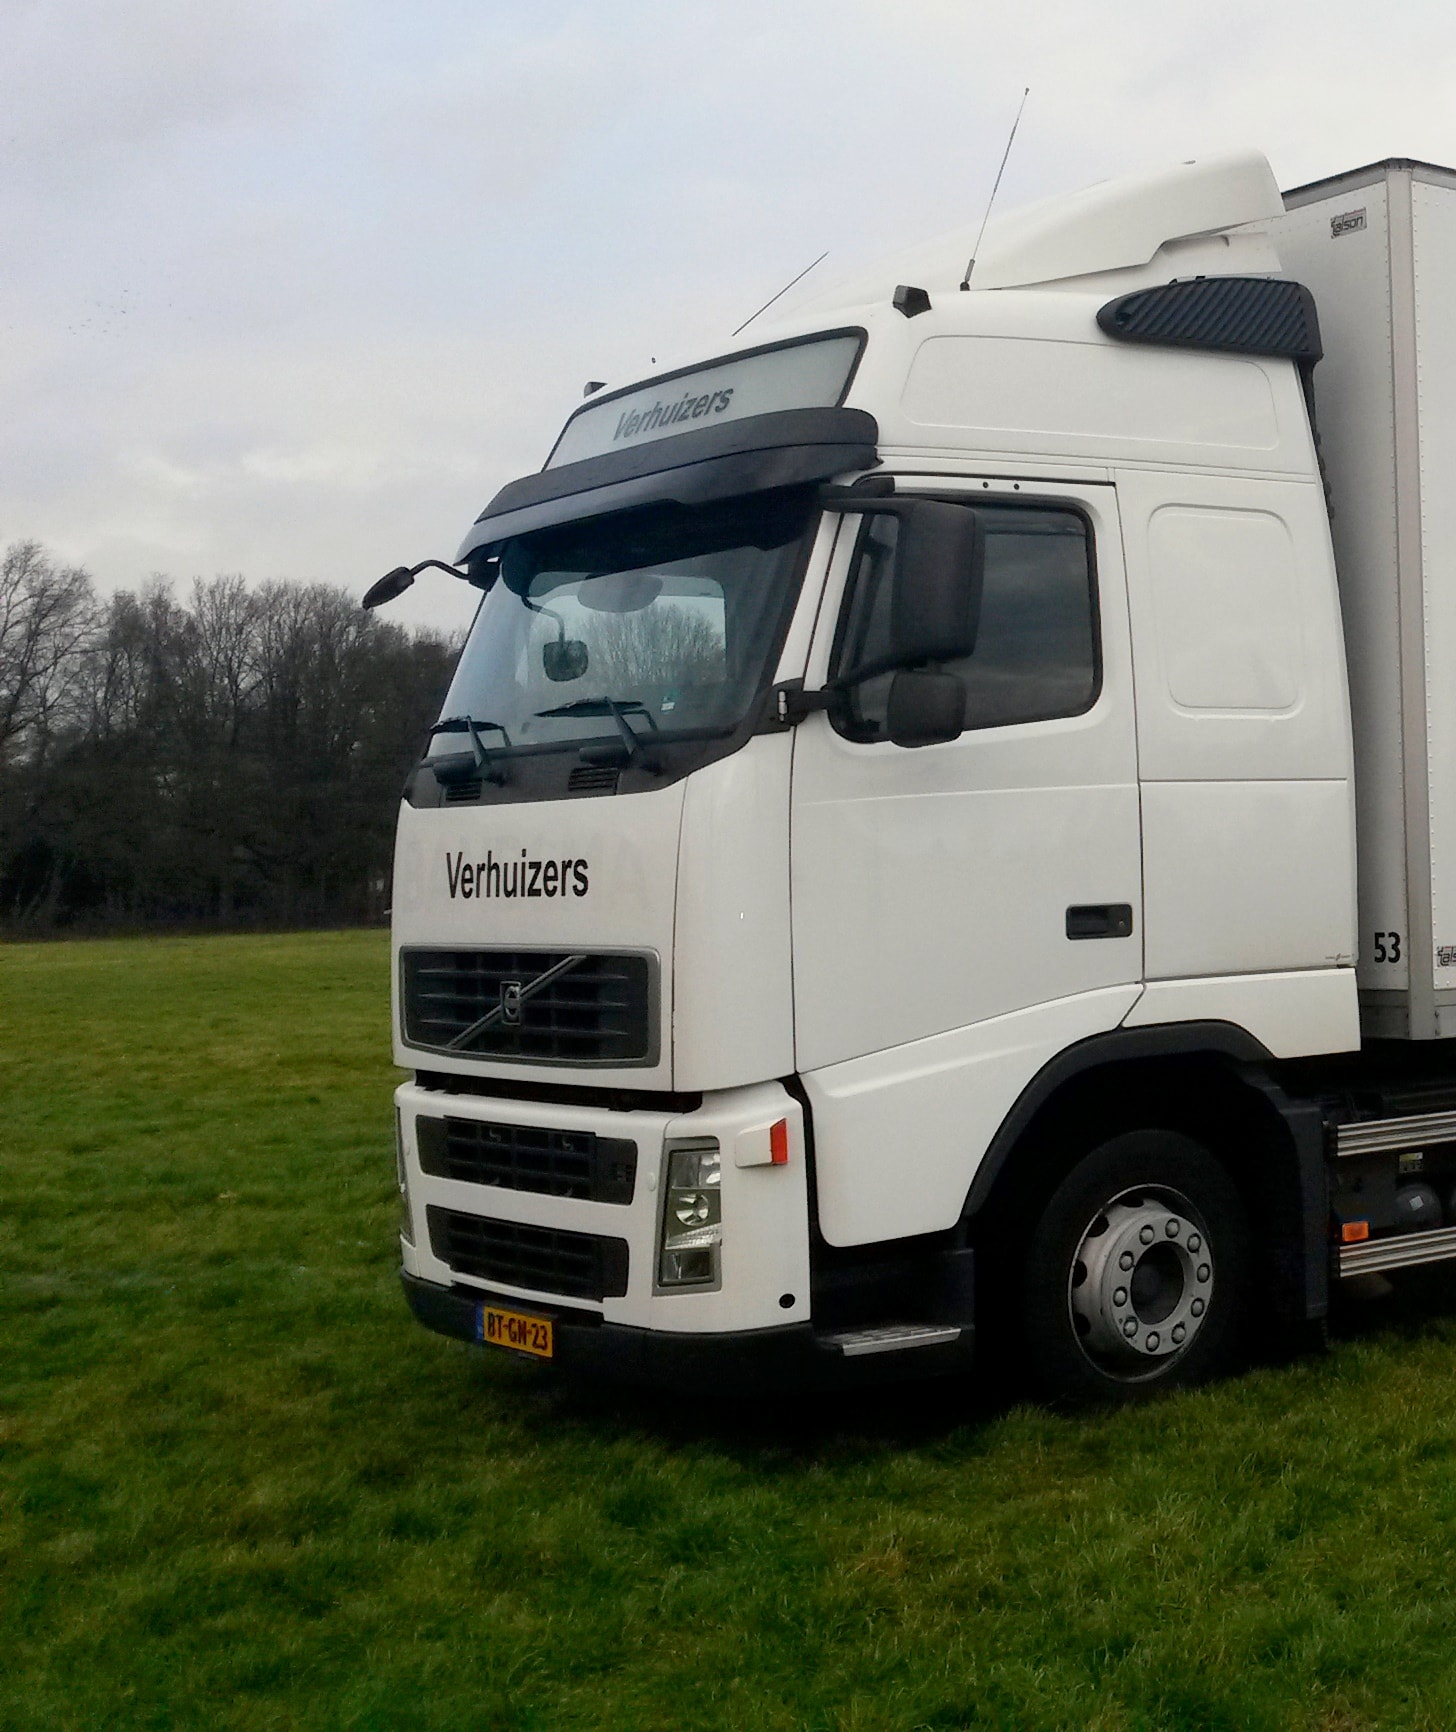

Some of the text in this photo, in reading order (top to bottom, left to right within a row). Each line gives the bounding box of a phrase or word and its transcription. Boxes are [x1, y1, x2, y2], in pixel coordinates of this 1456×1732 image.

[612, 385, 734, 441] Verhuizers
[446, 849, 589, 899] Verhuizers
[1374, 932, 1401, 963] 53
[488, 1311, 548, 1351] BT-GN-23
